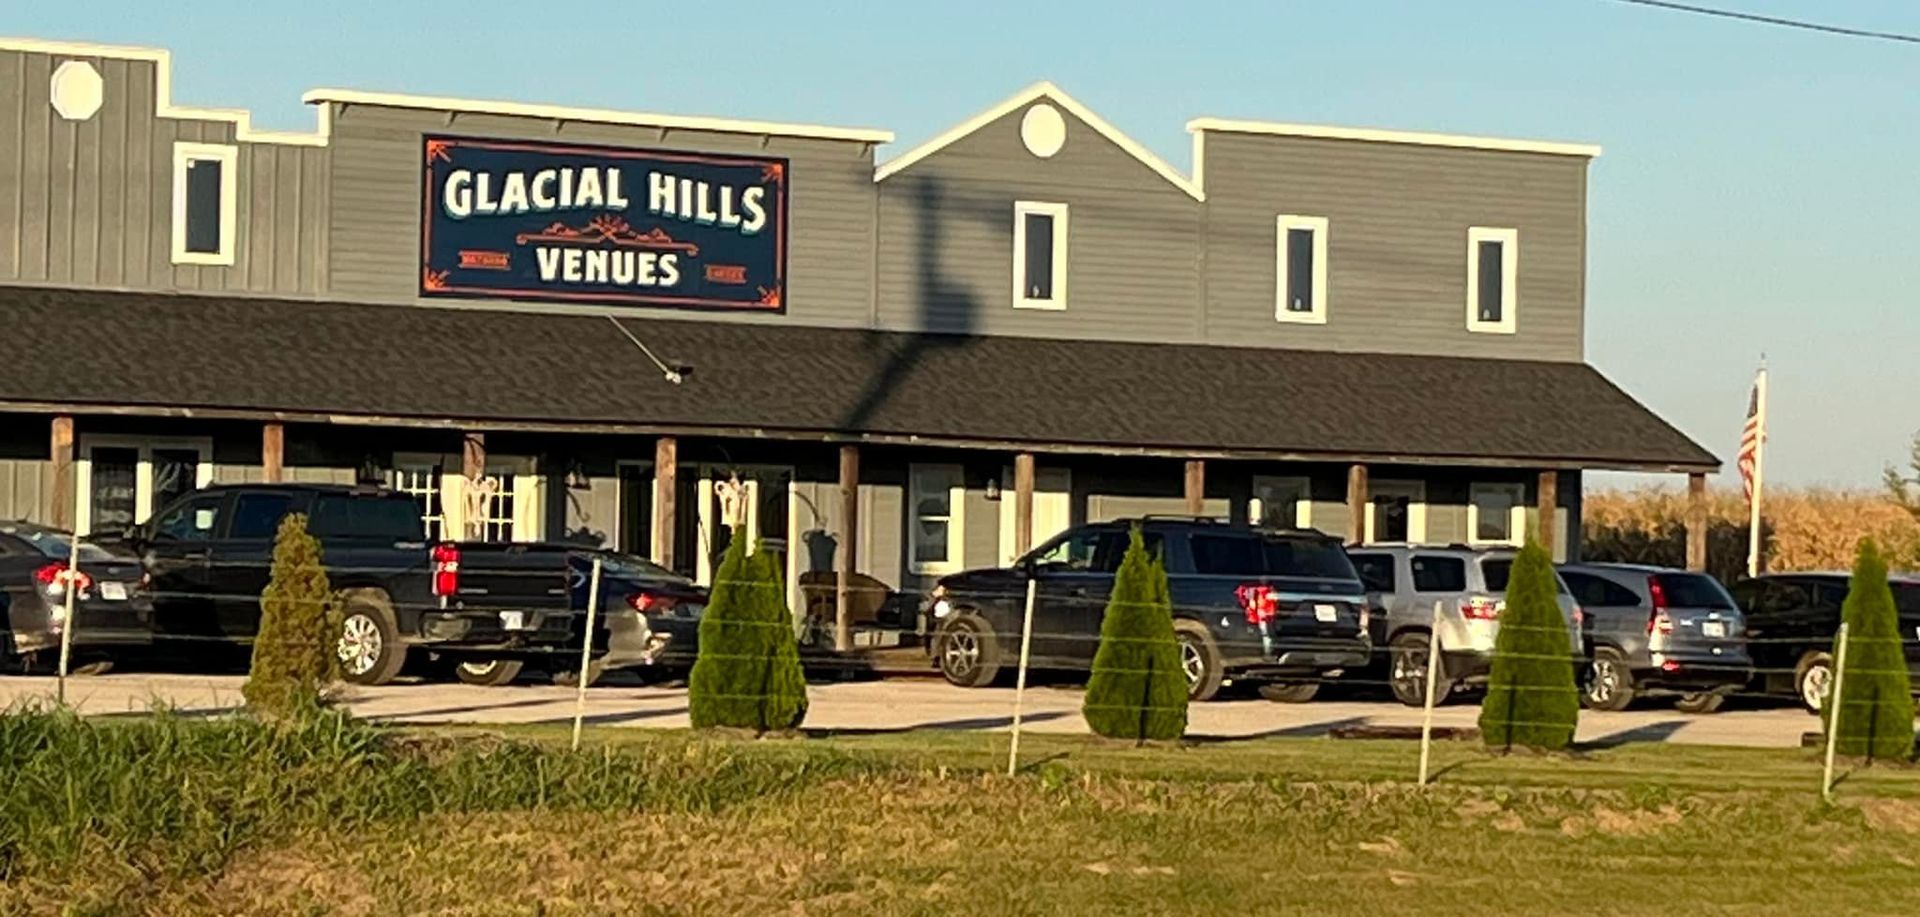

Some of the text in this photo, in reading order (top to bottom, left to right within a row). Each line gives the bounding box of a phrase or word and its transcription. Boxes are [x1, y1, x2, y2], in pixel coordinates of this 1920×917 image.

[444, 167, 766, 233] GLACIAL HILLS
[536, 247, 680, 286] VENUES
